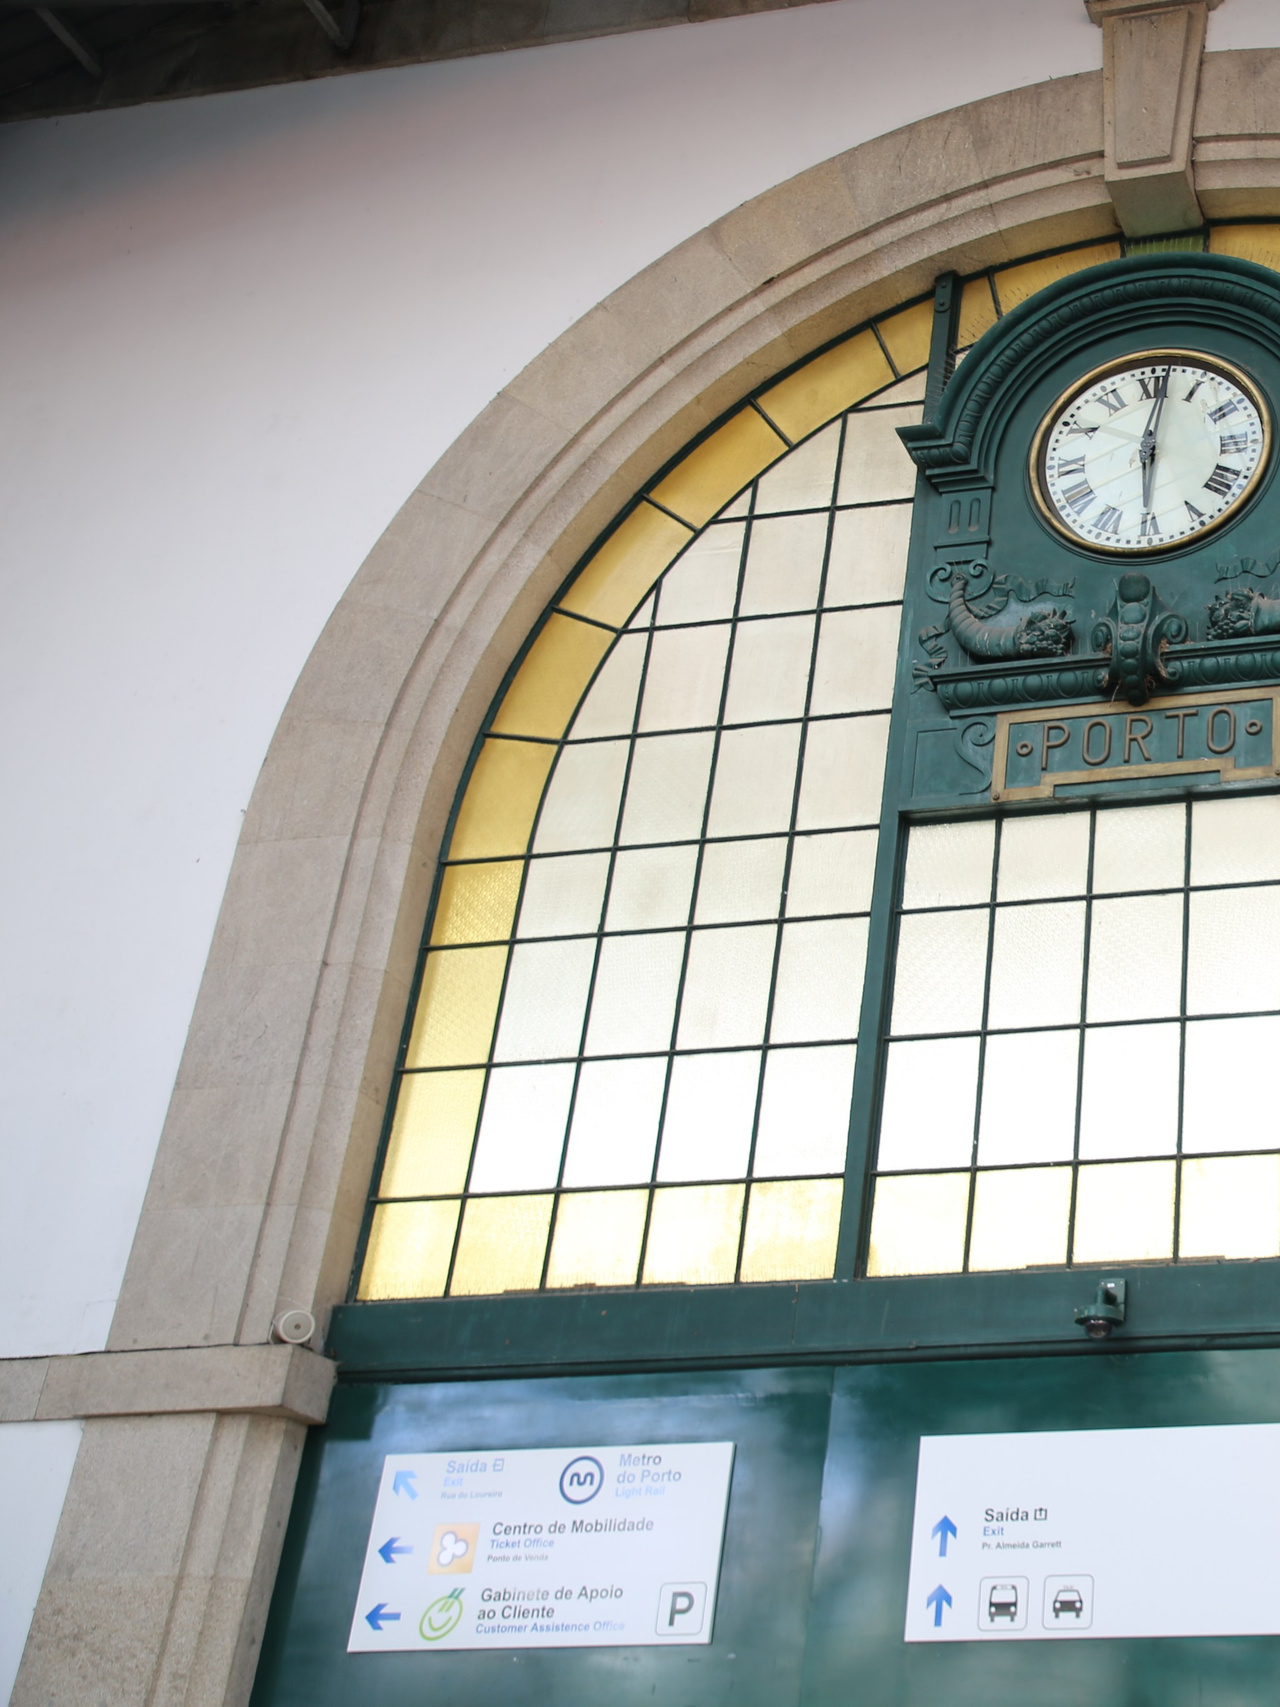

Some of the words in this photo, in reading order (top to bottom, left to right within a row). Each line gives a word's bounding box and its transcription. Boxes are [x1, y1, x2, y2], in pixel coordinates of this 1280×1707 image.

[1040, 706, 1237, 771] PORTO
[446, 1458, 488, 1474] Saída
[618, 1453, 662, 1467] Metro
[443, 1476, 463, 1487] Exit
[617, 1469, 636, 1484] do
[641, 1468, 682, 1483] Porto
[440, 1491, 456, 1500] Rua
[457, 1491, 469, 1499] do
[470, 1489, 503, 1499] Loureiro
[615, 1486, 643, 1499] Light
[645, 1485, 666, 1497] Rail
[984, 1507, 1029, 1522] Saída
[492, 1521, 543, 1536] Centro
[548, 1520, 567, 1535] de
[571, 1517, 654, 1534] Mobilidade
[982, 1526, 1005, 1537] Exit
[490, 1538, 521, 1549] Ticket
[523, 1537, 555, 1548] Office
[982, 1541, 993, 1550] Pr.
[995, 1541, 1030, 1550] Almeida
[1032, 1540, 1062, 1549] Garrett
[486, 1554, 511, 1563] Ponto
[512, 1554, 523, 1562] de
[524, 1553, 549, 1562] Venda
[481, 1586, 550, 1602] Gabinete
[554, 1585, 573, 1600] de
[577, 1584, 624, 1603] Apoio
[477, 1607, 496, 1620] ao
[501, 1605, 555, 1619] Cliente
[668, 1591, 695, 1628] P
[475, 1621, 528, 1634] Customer
[530, 1620, 590, 1633] Assistence
[592, 1619, 625, 1631] Office
